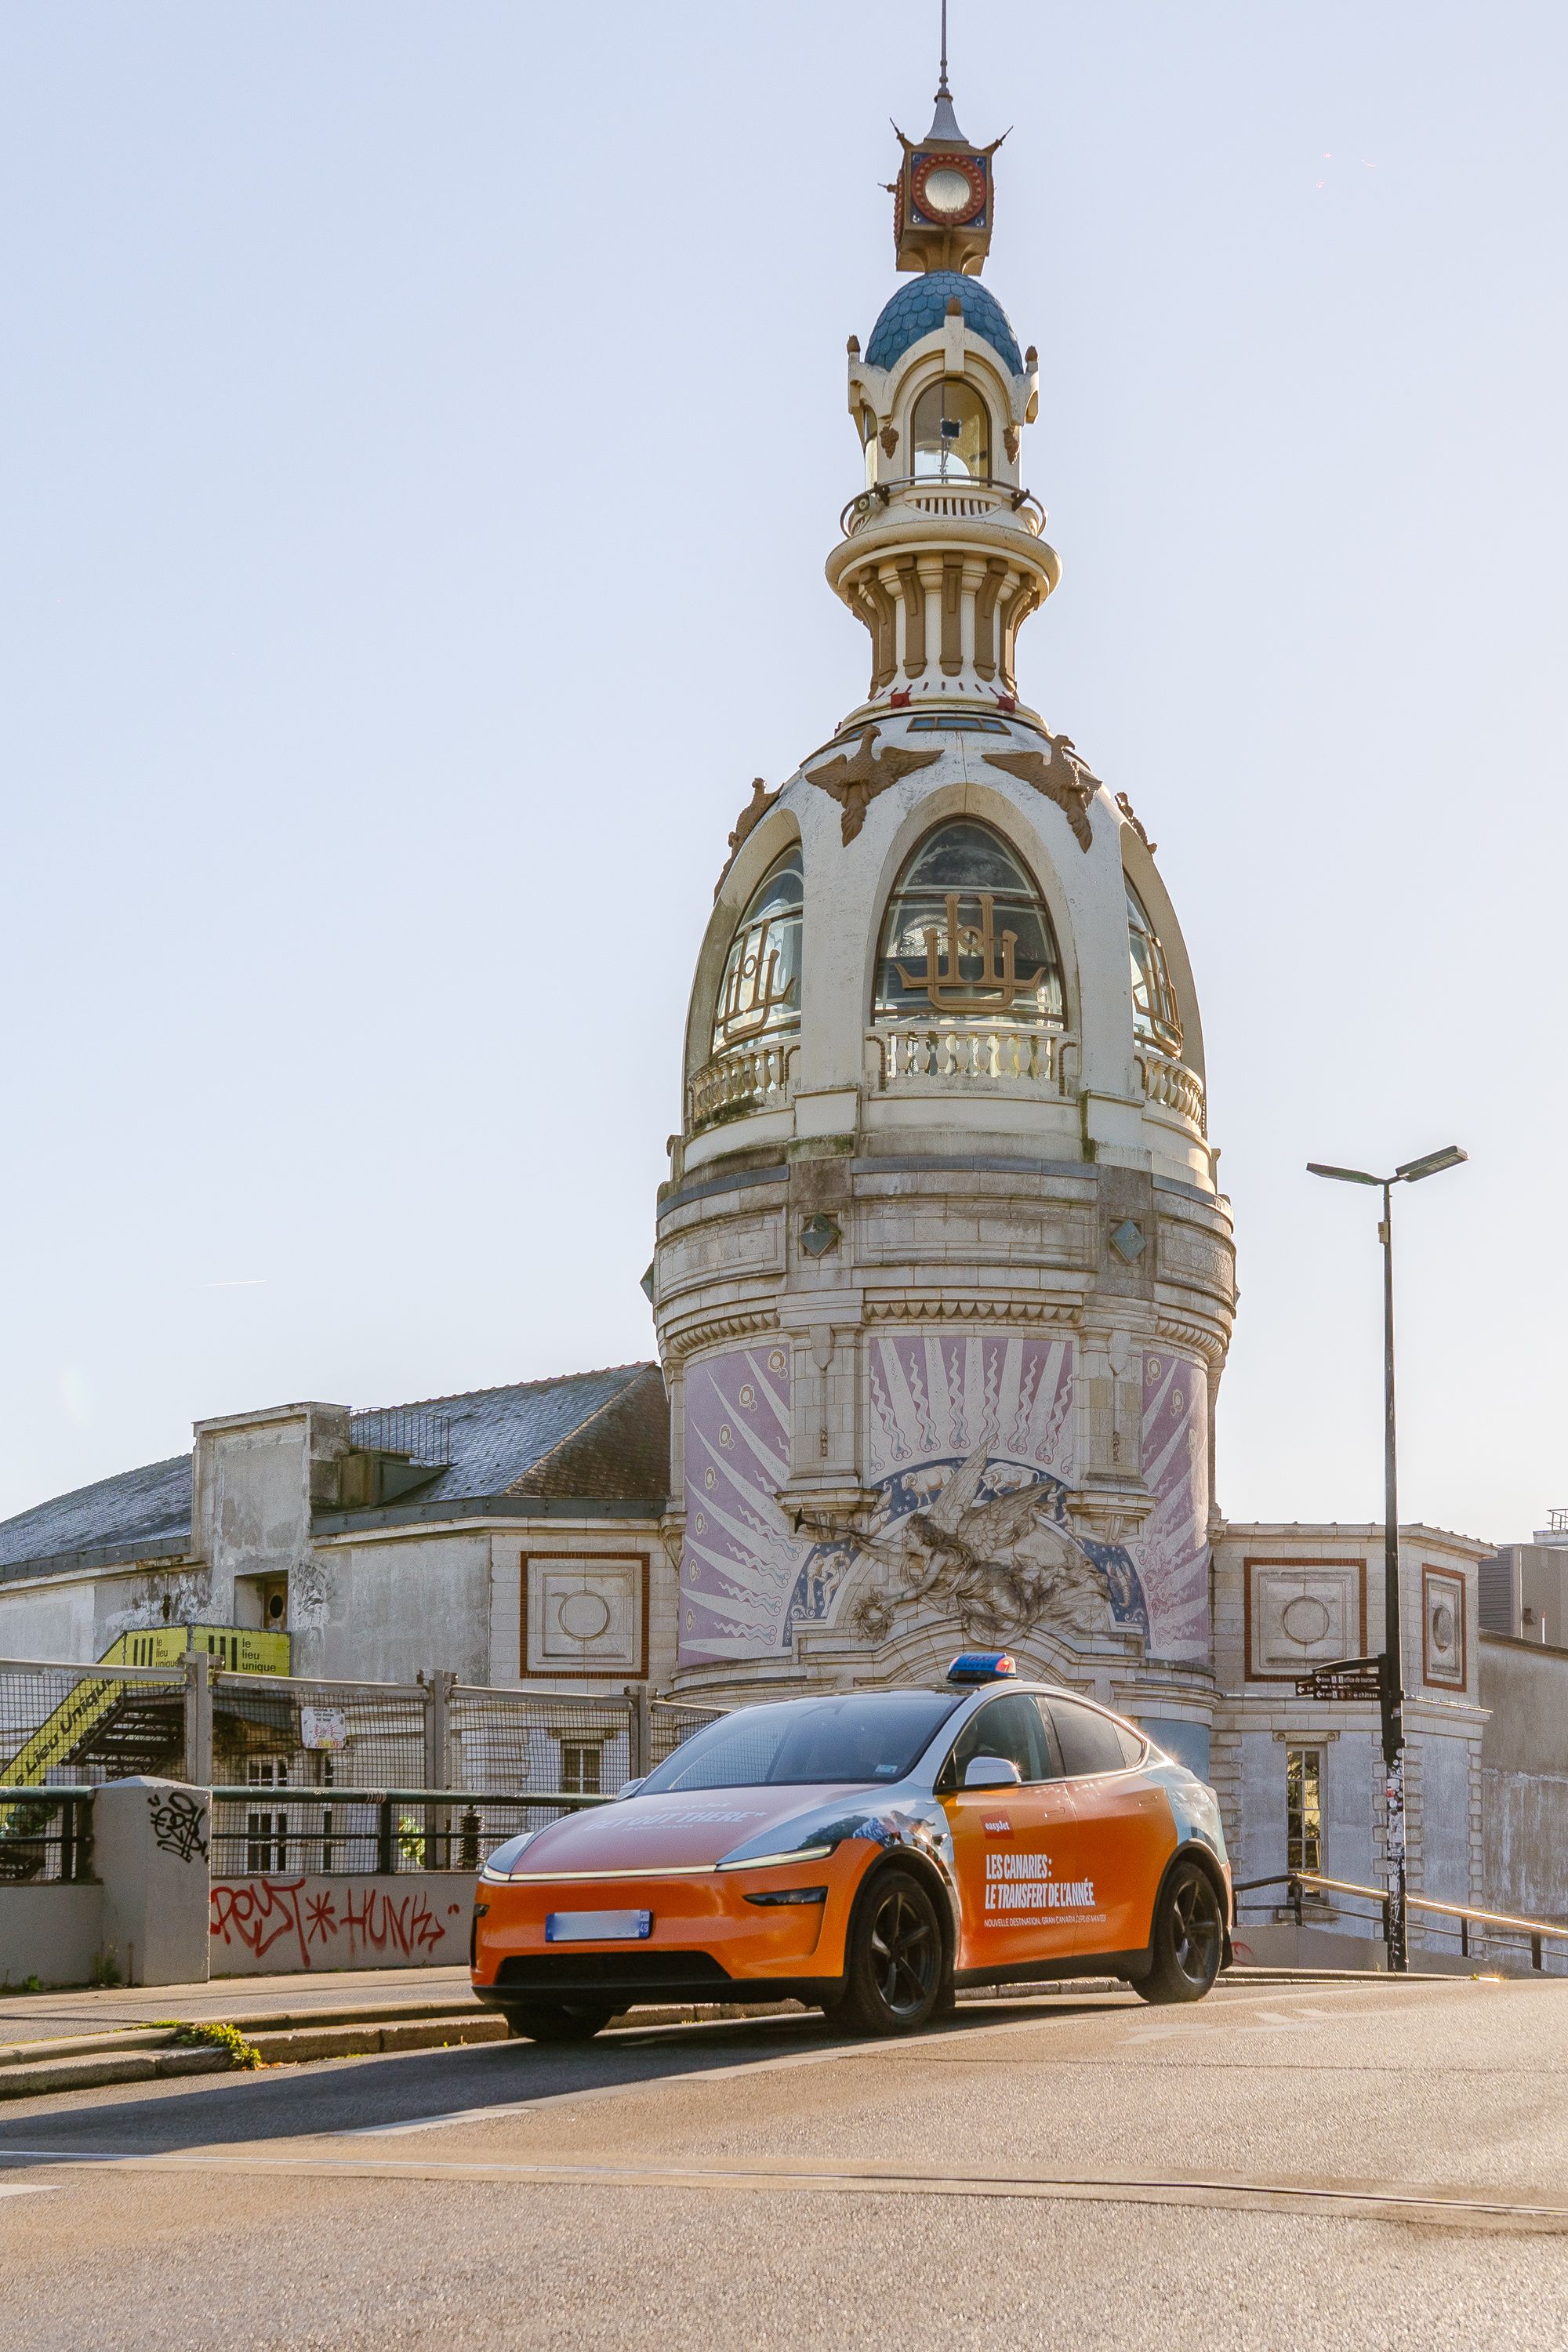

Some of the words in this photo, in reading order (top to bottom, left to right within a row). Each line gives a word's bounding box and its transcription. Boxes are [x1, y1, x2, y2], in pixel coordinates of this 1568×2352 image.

[157, 1636, 162, 1646] le
[242, 1638, 252, 1648] le
[157, 1647, 169, 1657] lieu
[242, 1650, 260, 1661] lieu
[242, 1661, 276, 1673] unique
[985, 1820, 1011, 1832] easyJet
[985, 1854, 1004, 1880] LES
[985, 1884, 996, 1910] LE
[997, 1882, 1047, 1909] TRANSFERT
[1048, 1882, 1059, 1907] DE
[984, 1918, 1010, 1927] NOUVELLE
